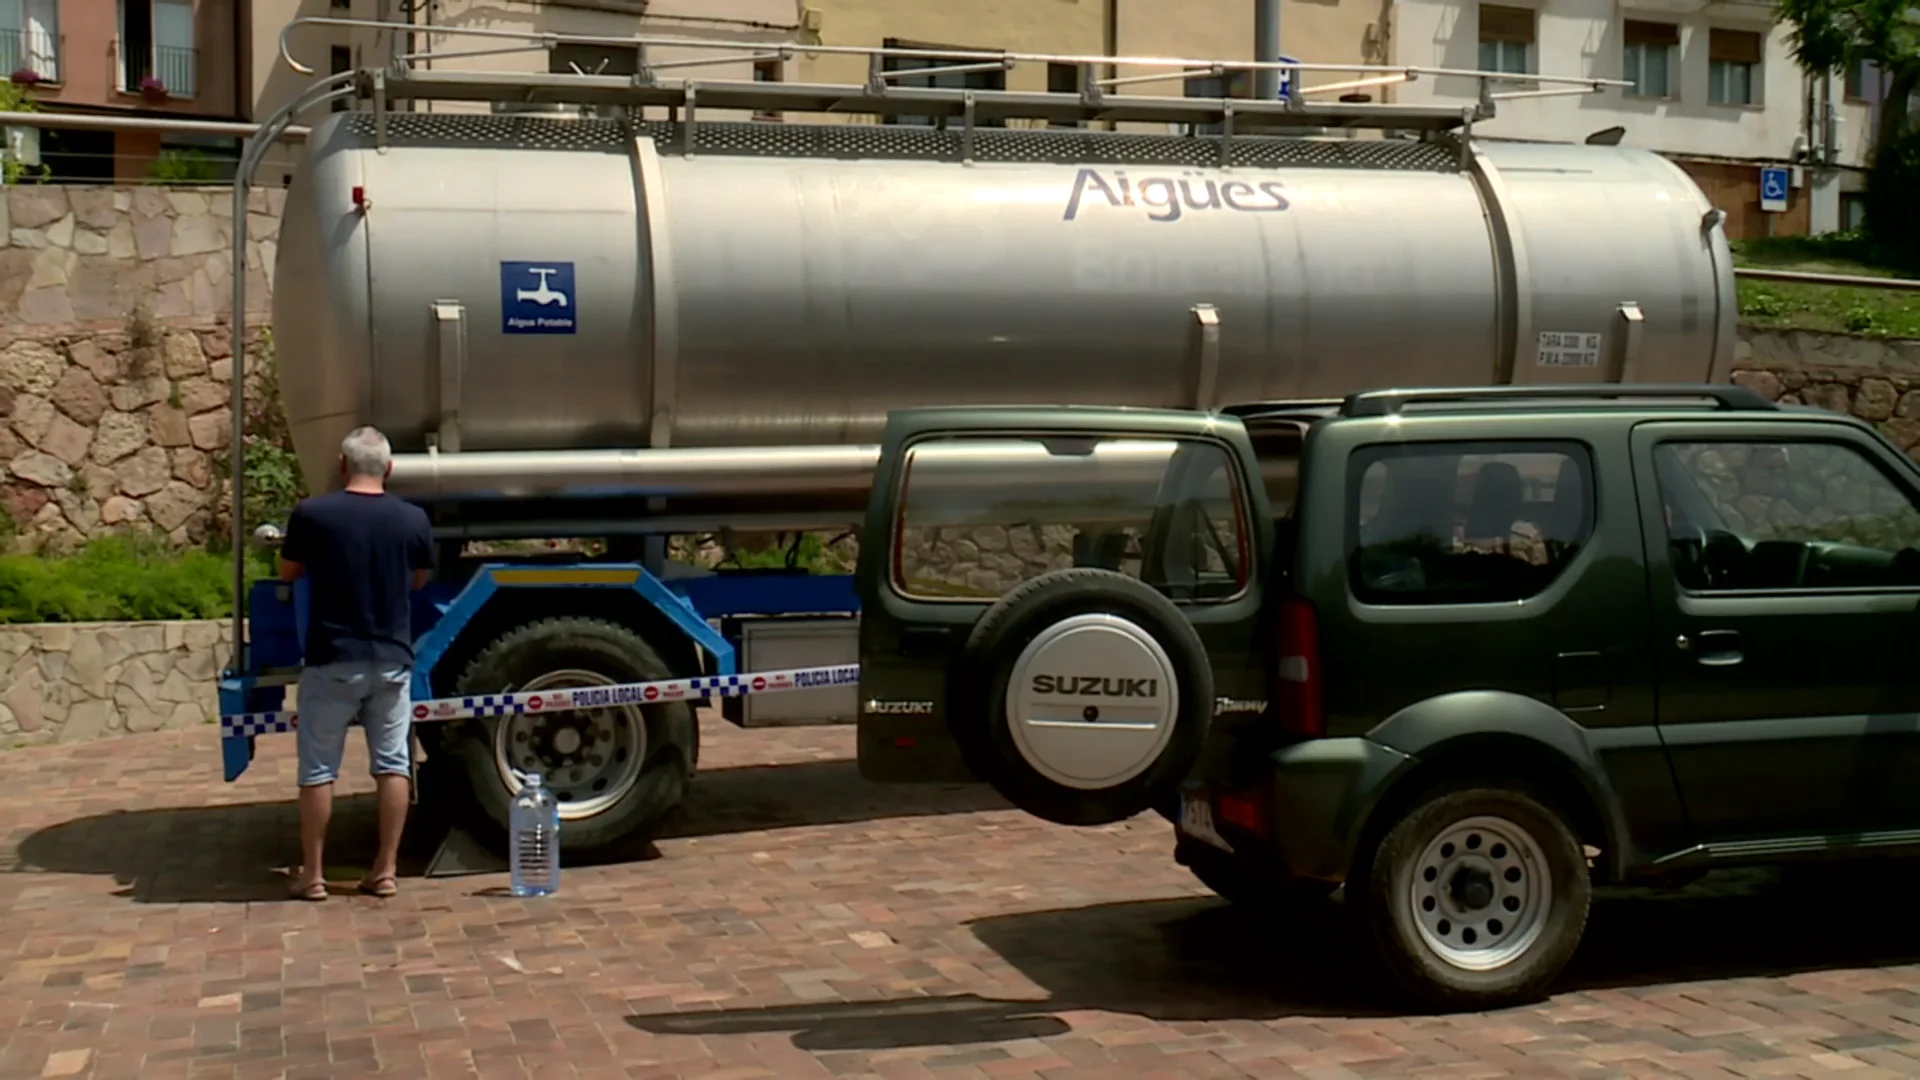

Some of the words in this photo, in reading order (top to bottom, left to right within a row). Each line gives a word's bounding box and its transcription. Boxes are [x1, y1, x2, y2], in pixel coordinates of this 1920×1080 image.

[1062, 167, 1290, 222] Aigües
[795, 669, 830, 688] POLICIA
[1031, 674, 1158, 698] SUZUKI
[572, 690, 610, 706] POLICIA
[612, 686, 643, 704] LOCAL
[863, 701, 934, 714] SUZUKI
